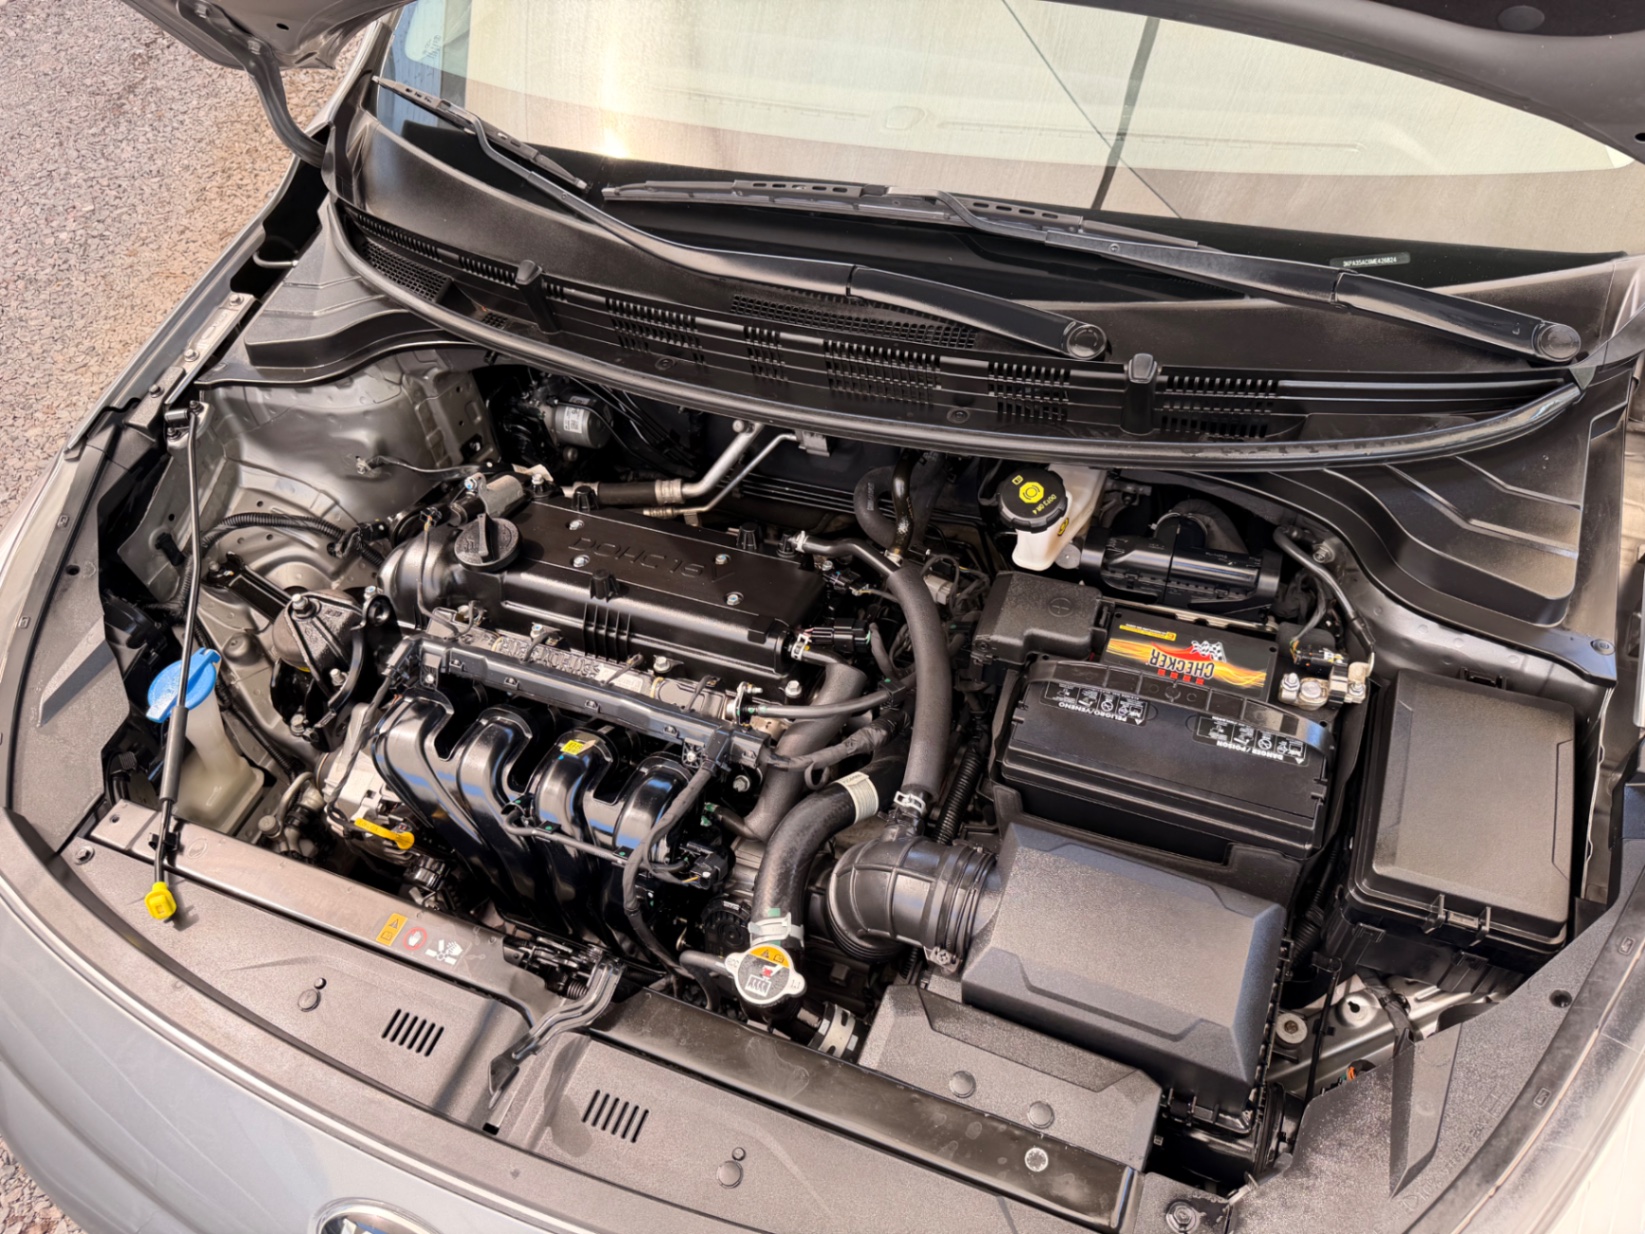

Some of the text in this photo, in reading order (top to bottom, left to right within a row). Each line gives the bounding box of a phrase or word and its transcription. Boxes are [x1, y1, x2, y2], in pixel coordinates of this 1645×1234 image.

[568, 537, 736, 584] DOHC 16V
[1150, 648, 1215, 679] CHECKER
[1216, 740, 1247, 753] POISON
[1251, 747, 1284, 761] DANGER
